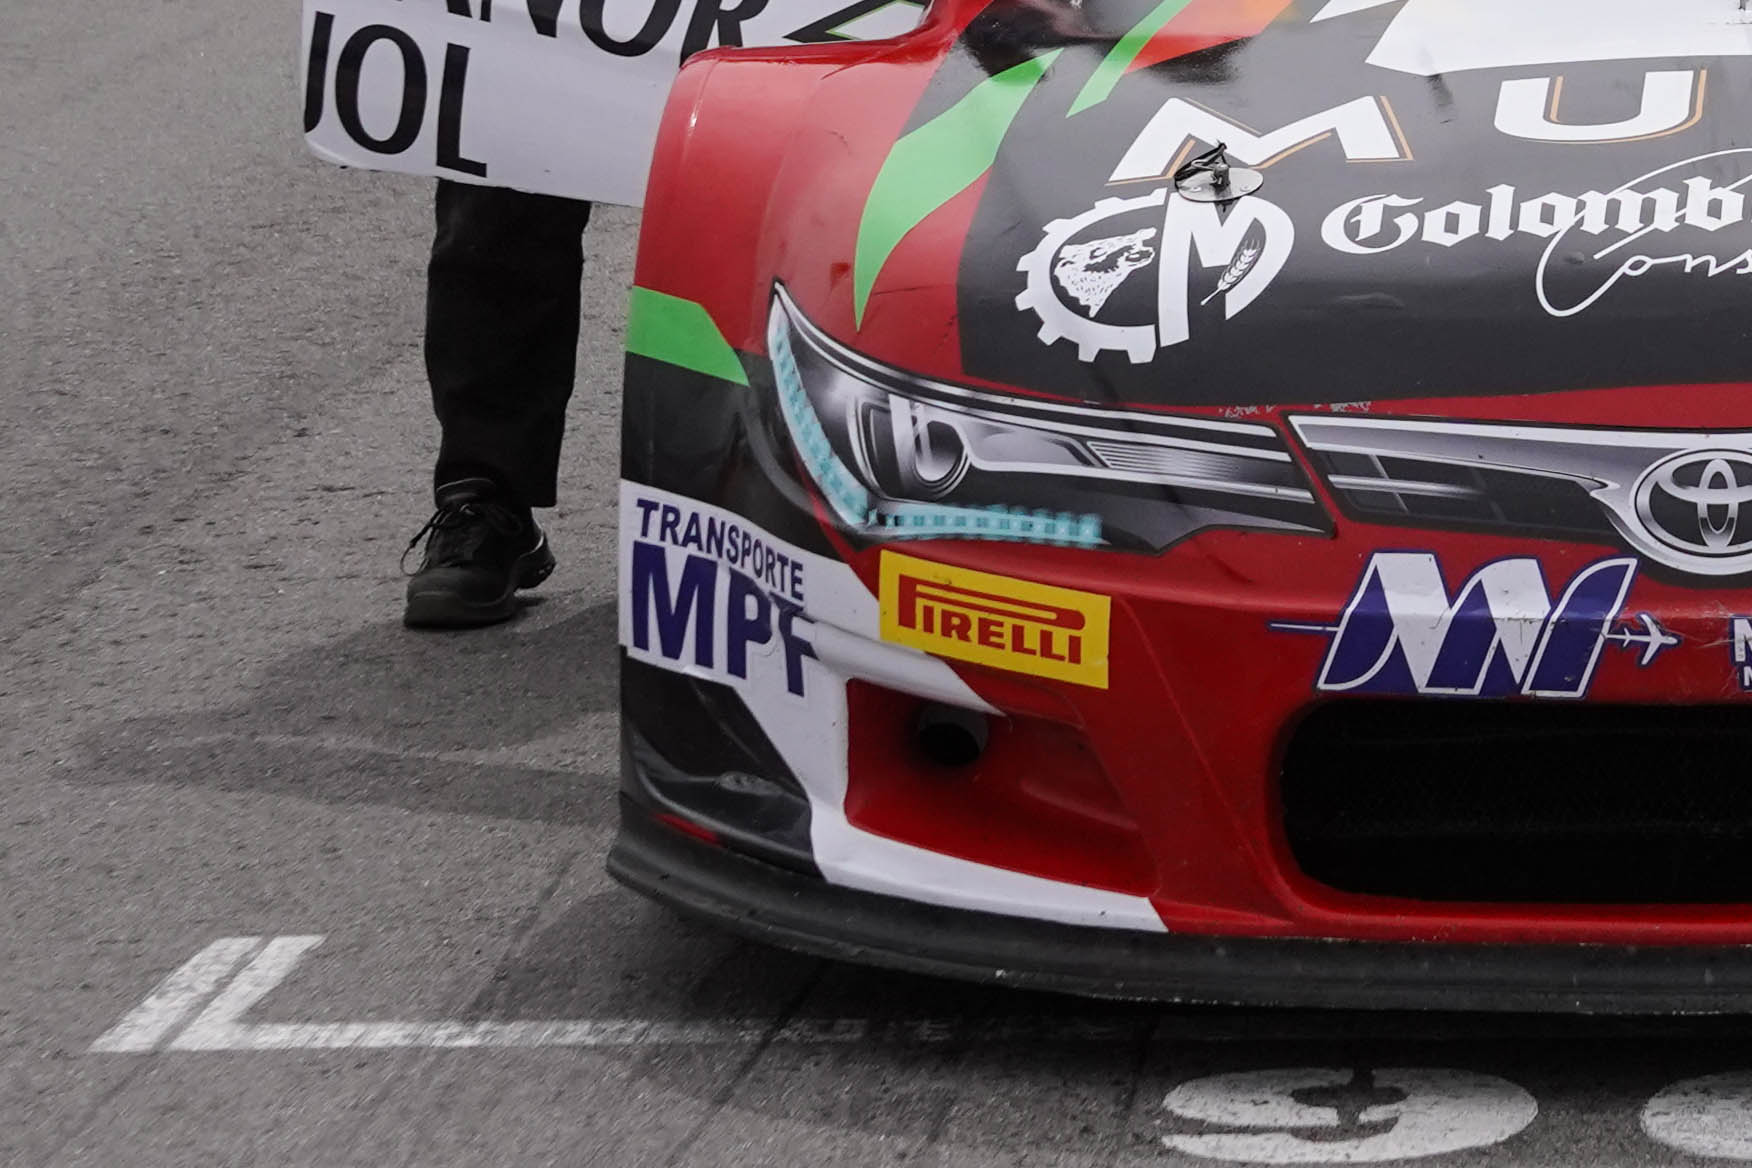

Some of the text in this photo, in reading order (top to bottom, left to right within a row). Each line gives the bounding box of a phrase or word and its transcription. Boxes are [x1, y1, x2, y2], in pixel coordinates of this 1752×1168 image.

[635, 498, 804, 592] TRANSPORTE
[630, 546, 820, 697] MPF
[898, 574, 1086, 665] PIRELLI
